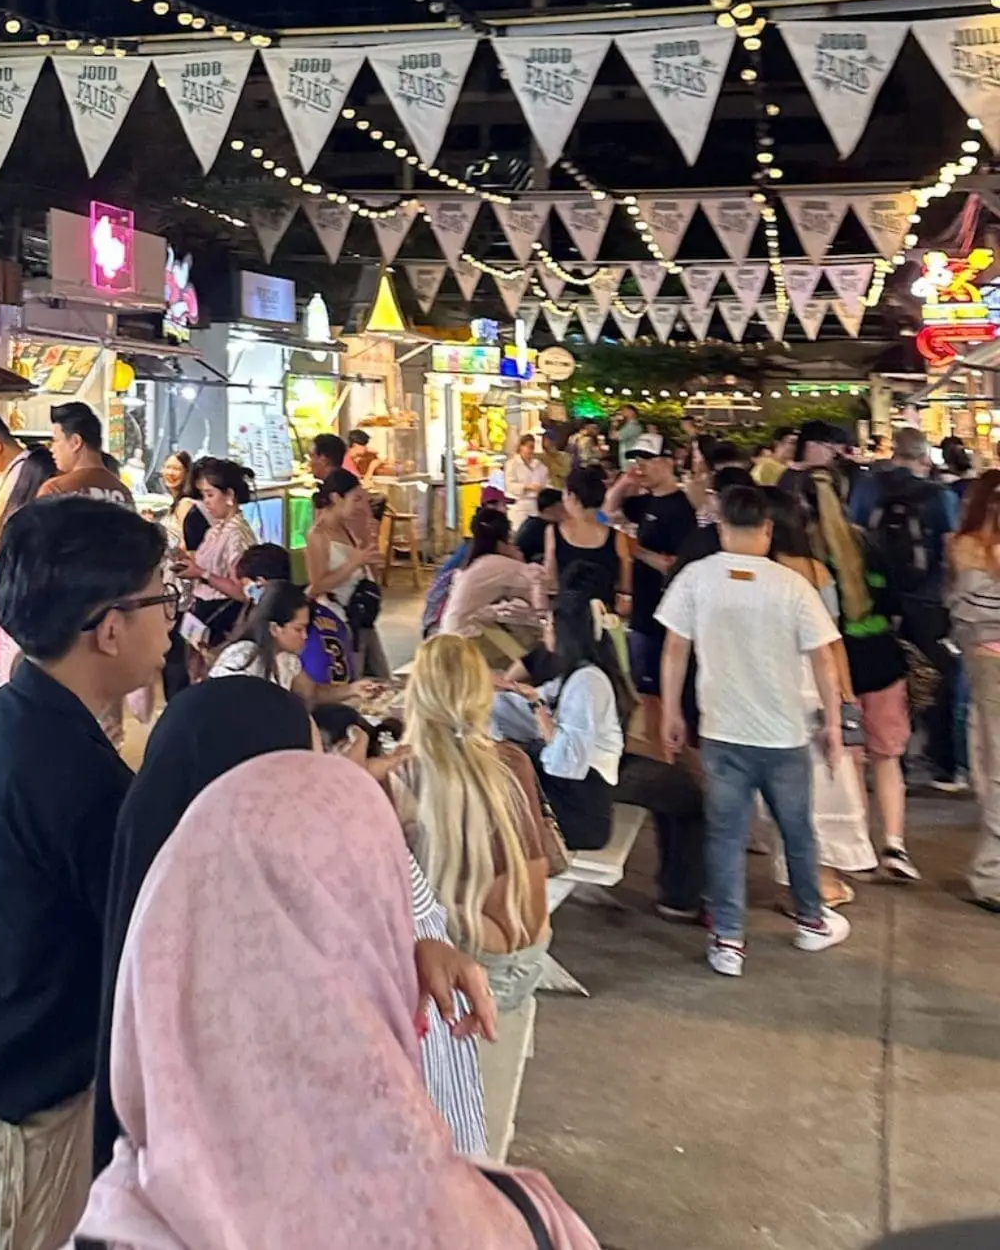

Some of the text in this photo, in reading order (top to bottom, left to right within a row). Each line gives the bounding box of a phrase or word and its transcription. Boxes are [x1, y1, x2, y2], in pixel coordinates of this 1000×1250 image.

[78, 65, 117, 81] JODD
[181, 61, 222, 78] JODD
[289, 58, 331, 73] JODD
[77, 80, 117, 115] FAIRS
[182, 79, 225, 110] FAIRS
[288, 73, 331, 109] FAIRS
[399, 70, 445, 103] FAIRS
